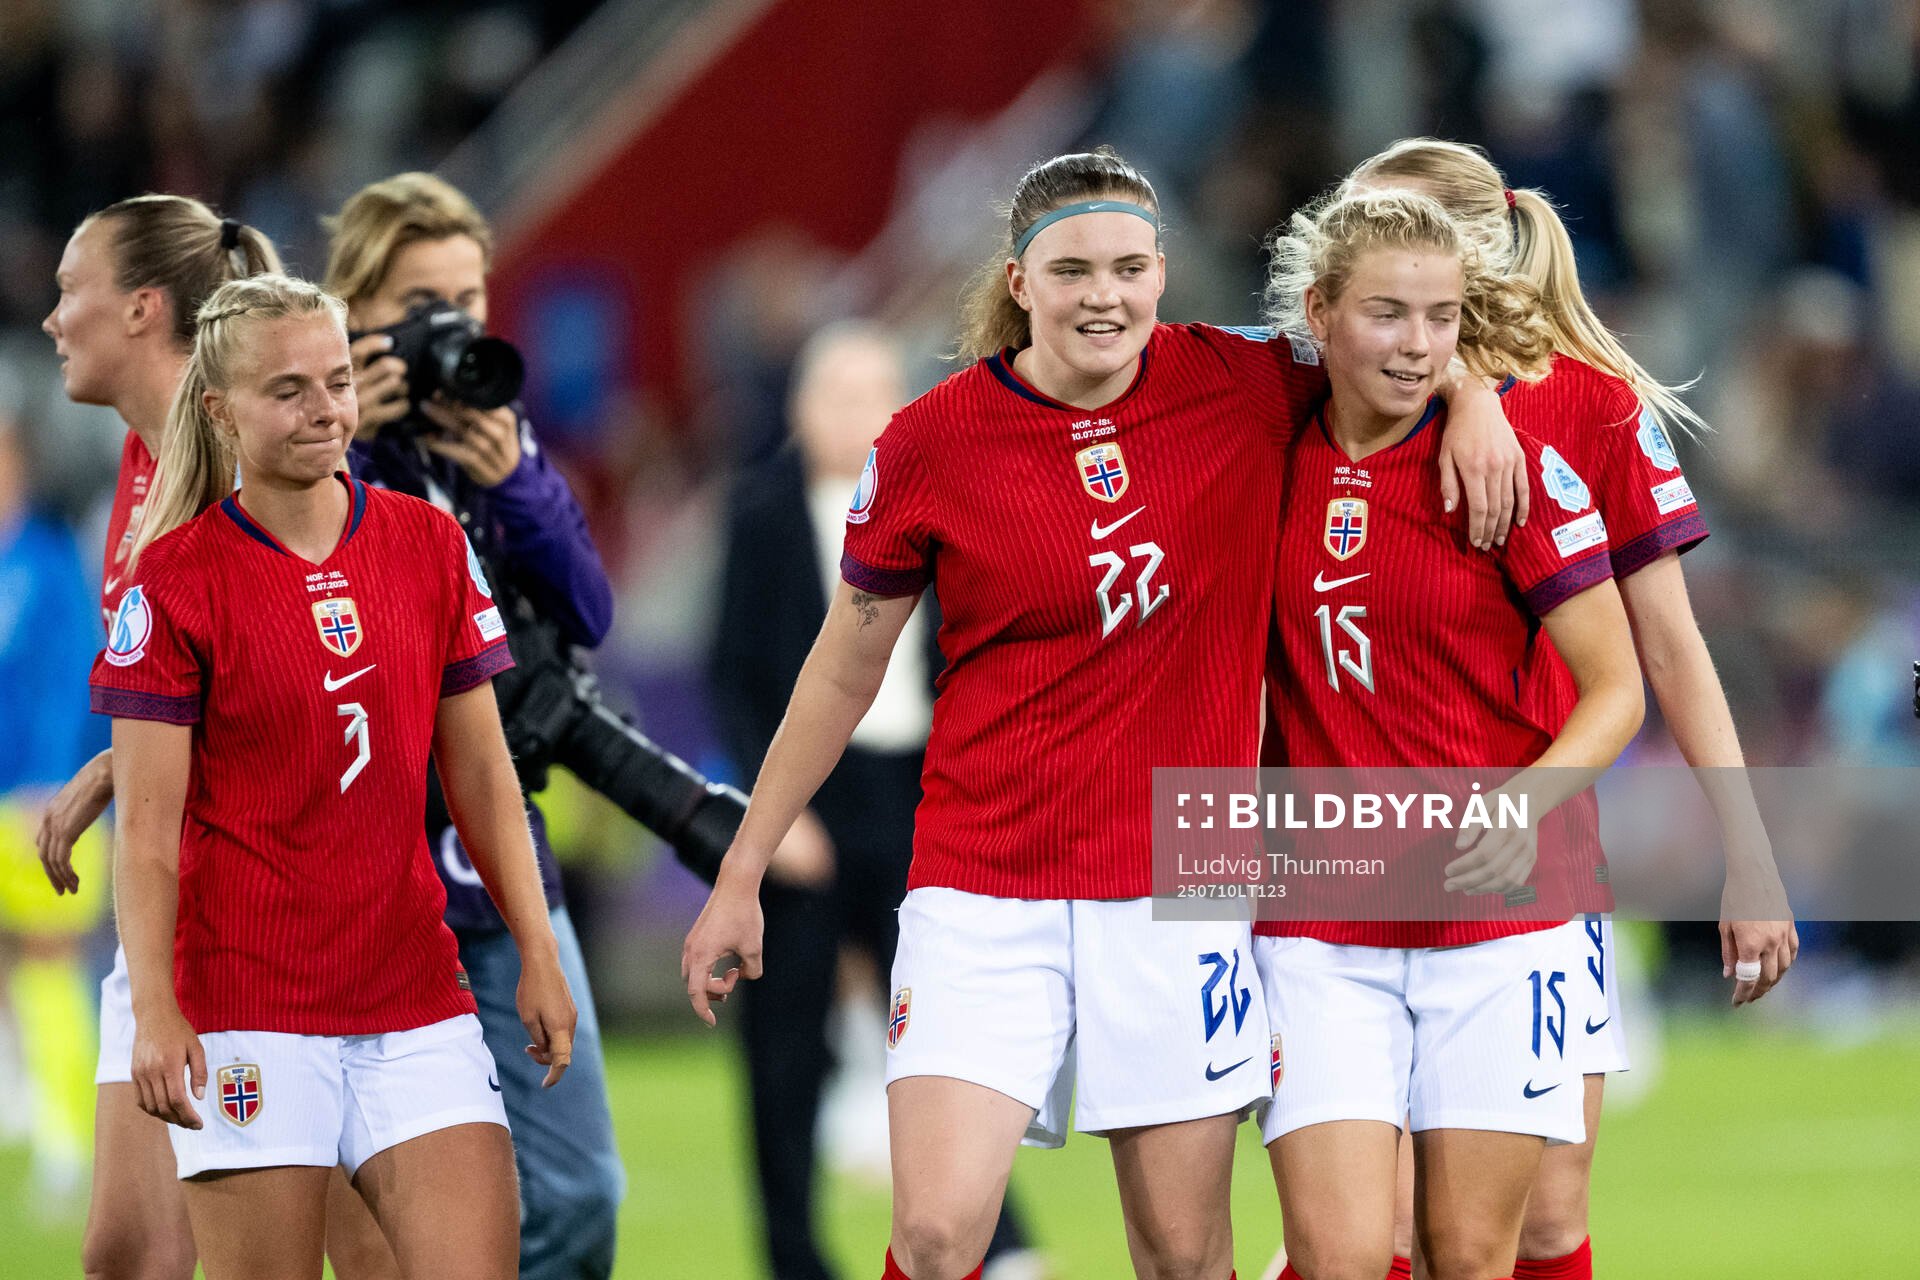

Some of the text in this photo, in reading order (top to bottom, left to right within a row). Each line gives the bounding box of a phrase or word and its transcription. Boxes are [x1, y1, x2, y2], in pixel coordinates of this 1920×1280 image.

[1072, 420, 1091, 430] NOR
[1072, 426, 1117, 440] 10.07.2025
[1335, 466, 1350, 475] NOR
[1357, 469, 1371, 479] ISL
[1333, 477, 1373, 488] 10.07.2025
[306, 572, 323, 582] NOR
[329, 571, 344, 579] ISL
[306, 580, 349, 592] 10.07.2025
[1088, 541, 1169, 640] 22
[1313, 604, 1375, 695] 15
[337, 702, 371, 795] 3
[1527, 970, 1565, 1060] 15
